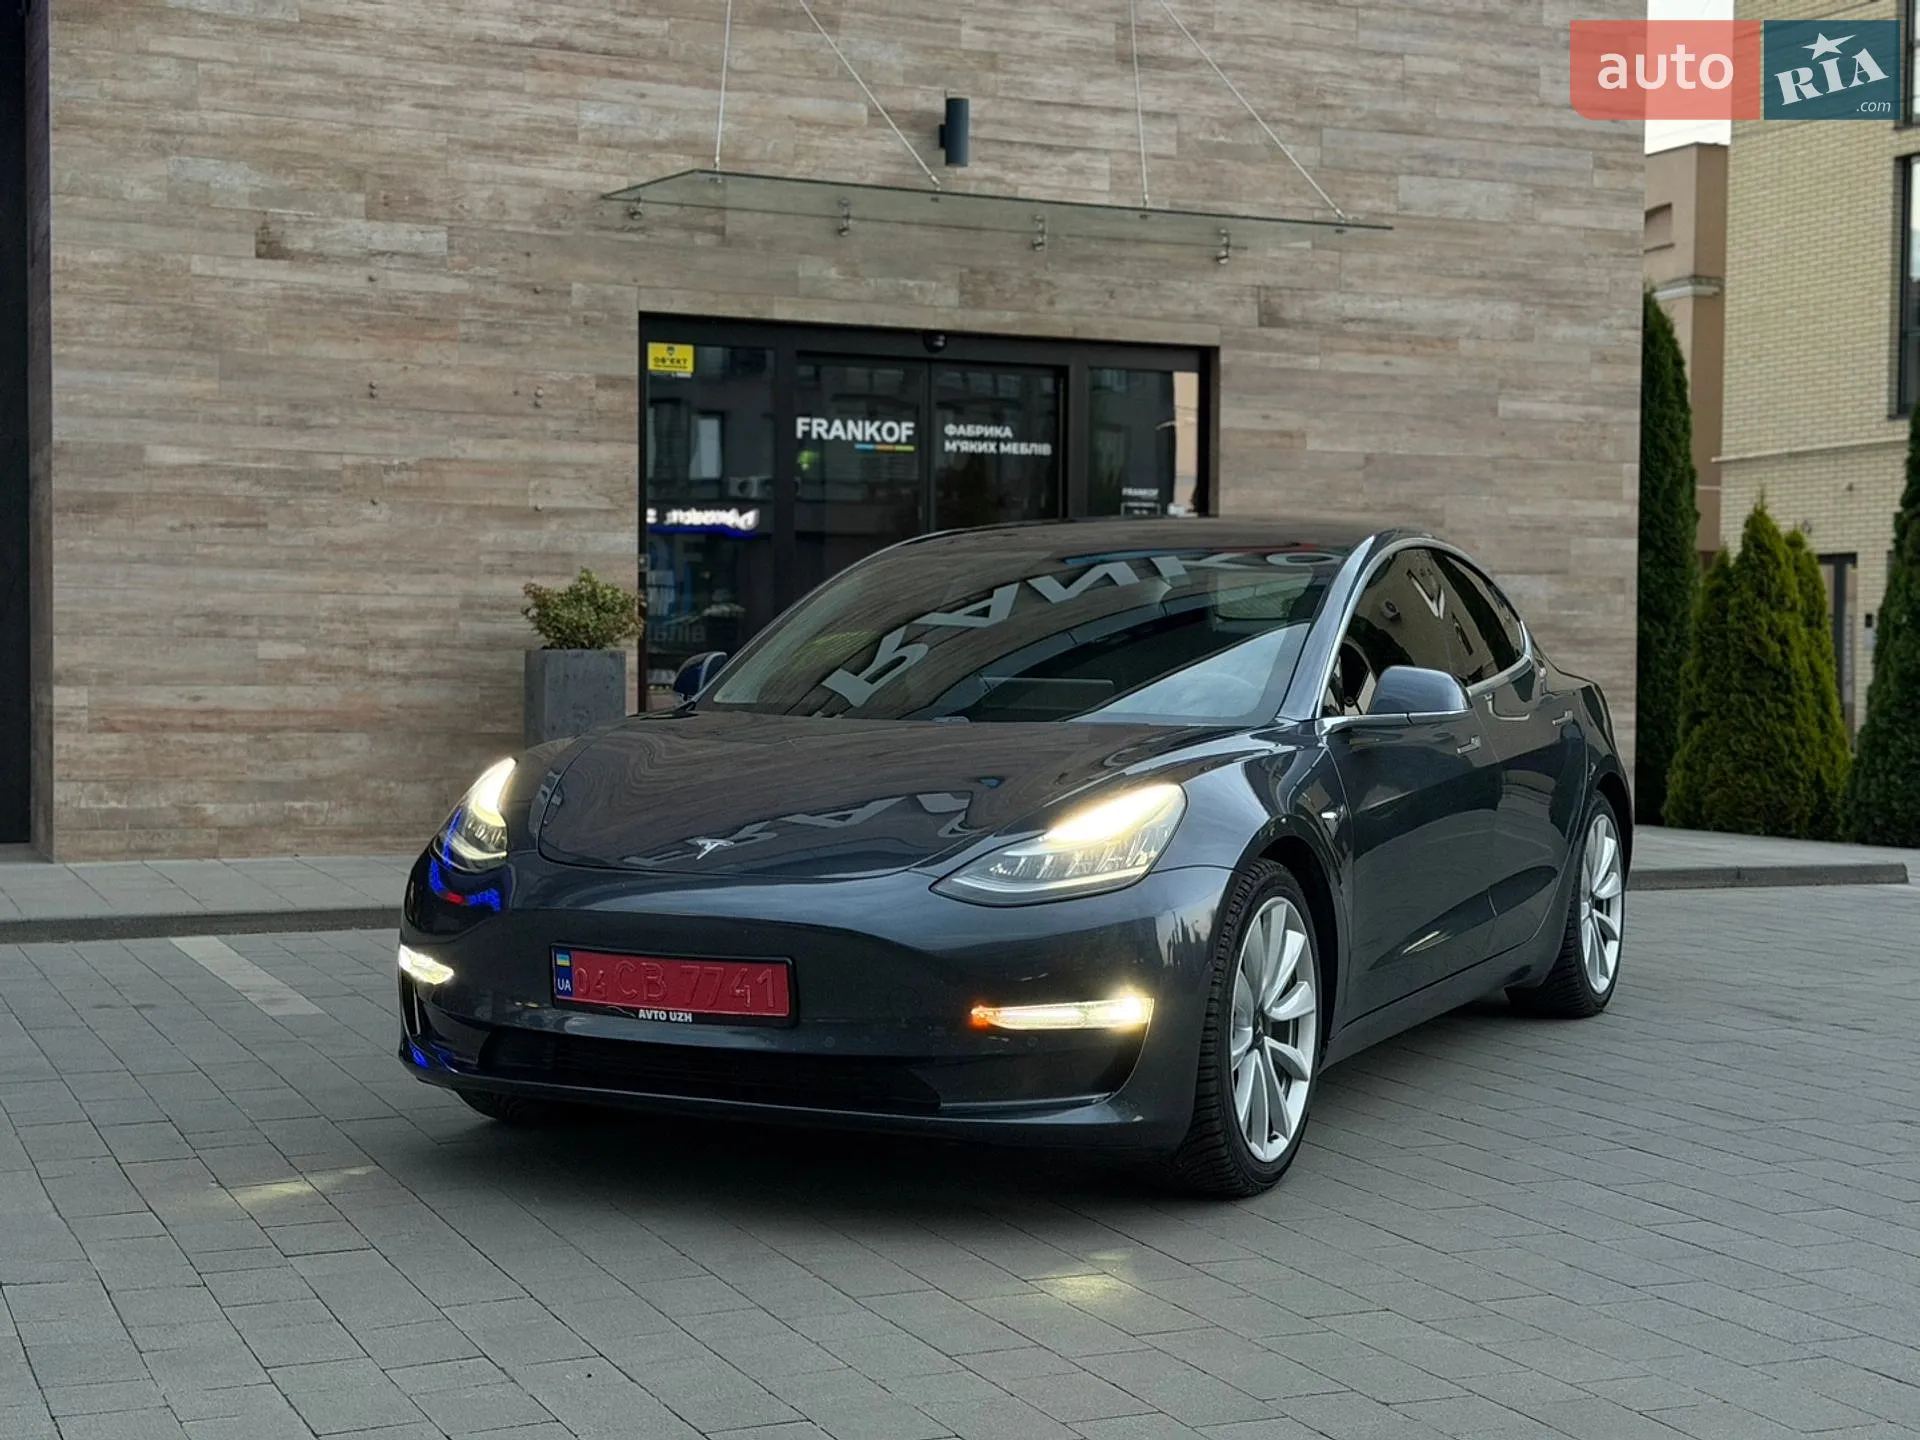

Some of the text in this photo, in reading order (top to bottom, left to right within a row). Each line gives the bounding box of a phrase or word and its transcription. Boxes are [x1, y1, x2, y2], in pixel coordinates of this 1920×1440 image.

[796, 417, 915, 443] FRANKOF
[944, 424, 1013, 438] ФАБРИКА
[944, 440, 1052, 456] М'ЯКИХ МЕБЛІВ
[557, 977, 572, 992] UA
[680, 964, 776, 1009] 7741
[638, 1009, 693, 1023] AVTO UZH
